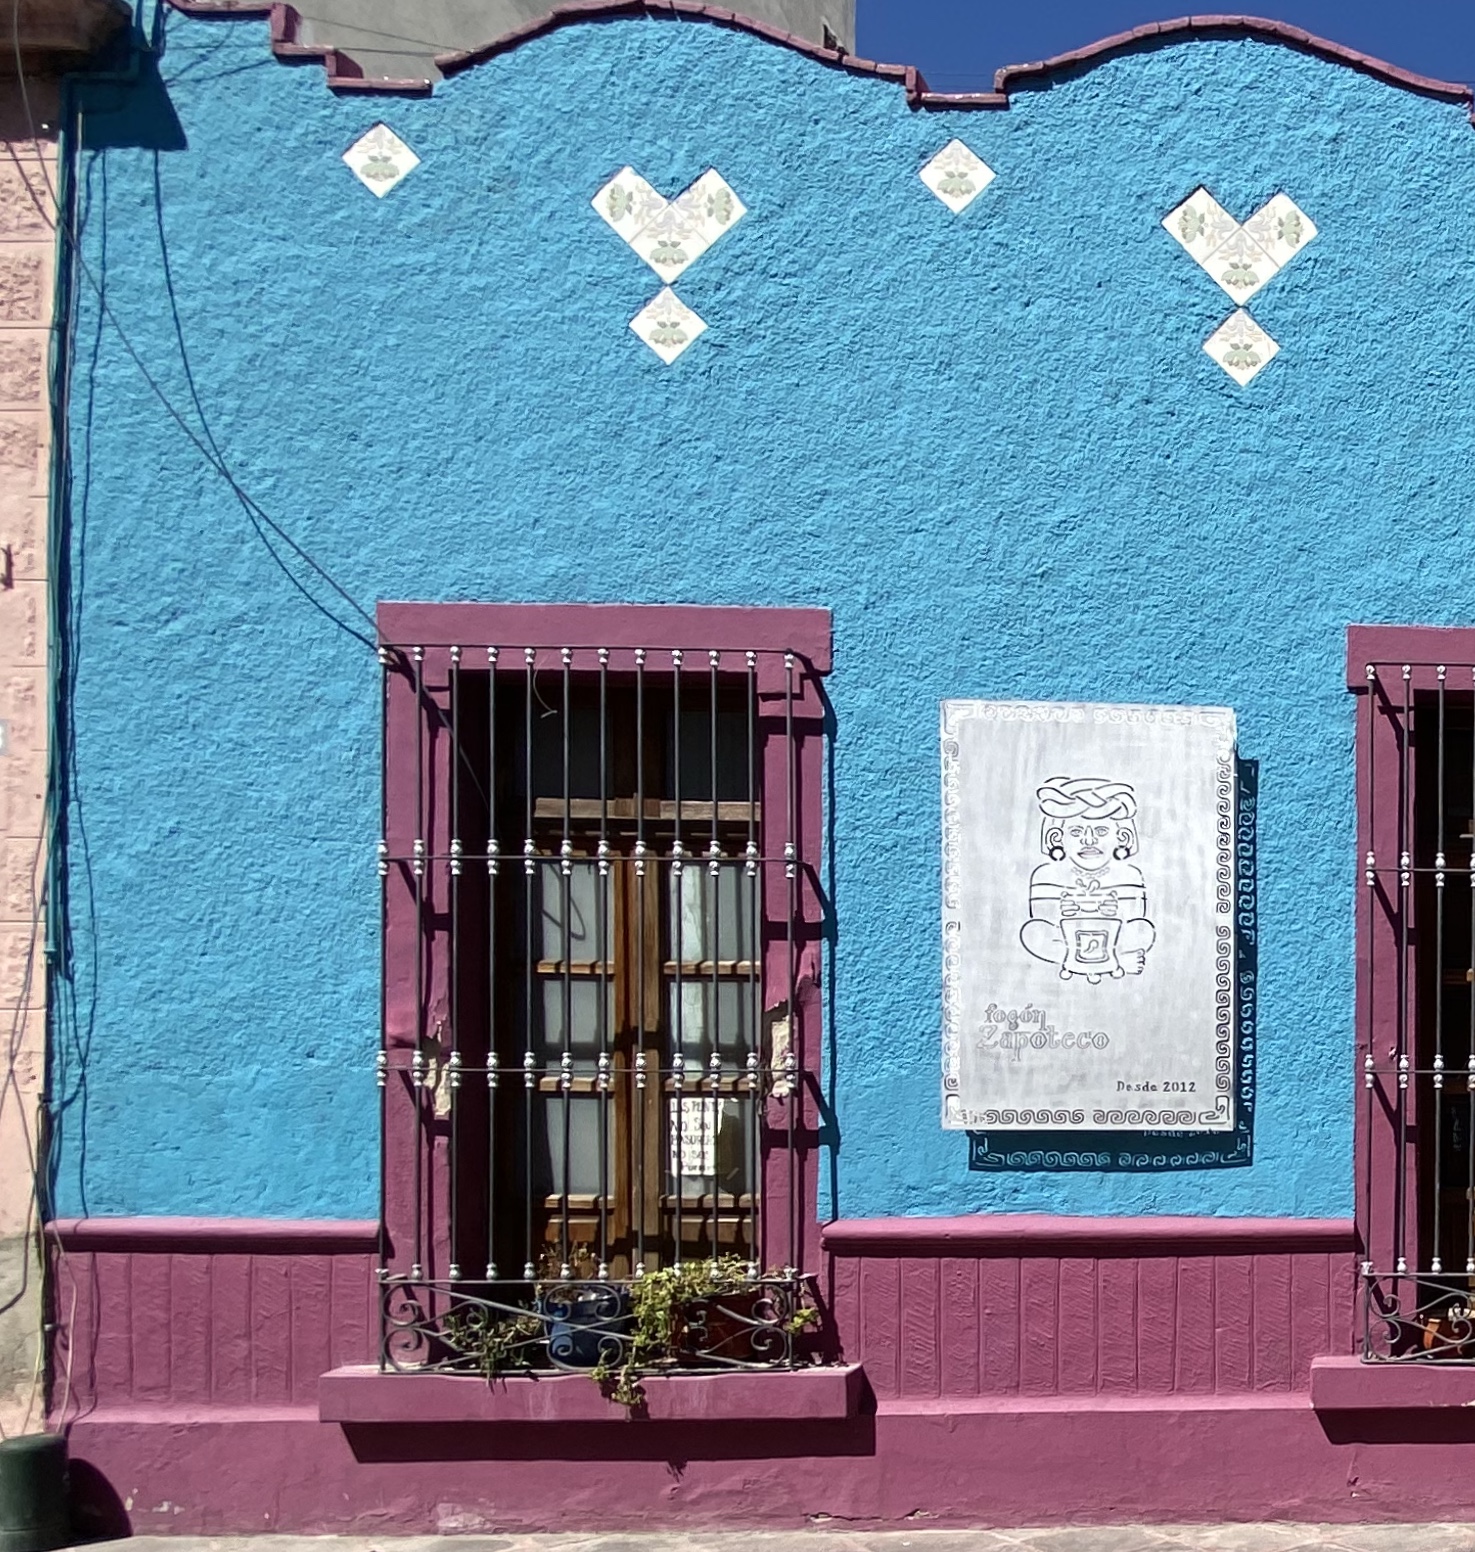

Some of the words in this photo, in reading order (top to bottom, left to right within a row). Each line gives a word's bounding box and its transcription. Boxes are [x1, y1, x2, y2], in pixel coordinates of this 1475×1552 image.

[984, 1003, 1047, 1031] fogón
[976, 1024, 1110, 1062] Zapoteco
[1116, 1080, 1158, 1092] Desde
[1162, 1081, 1197, 1093] 2012
